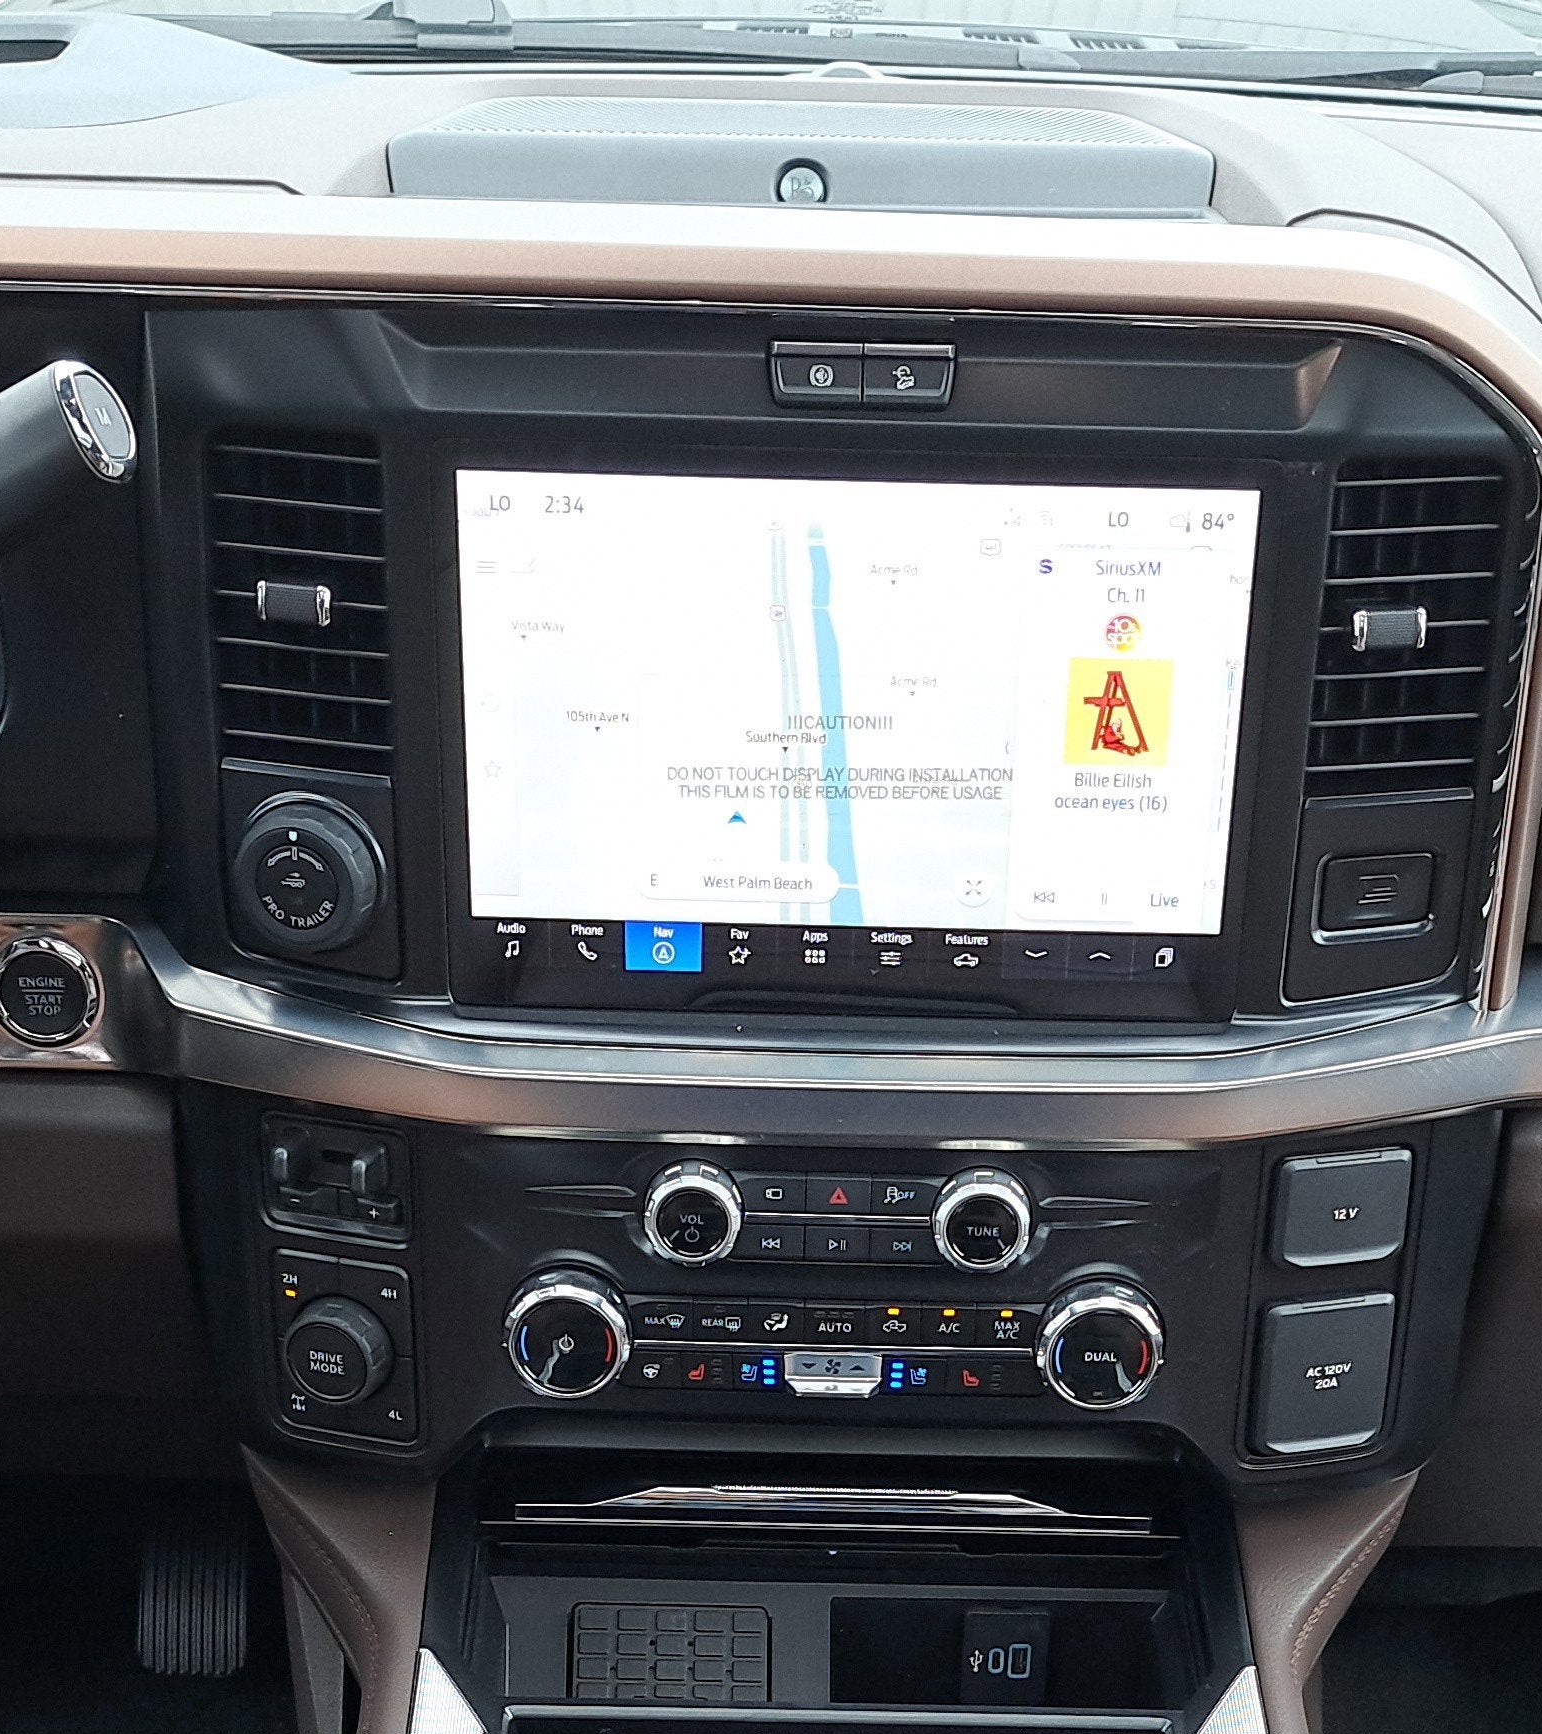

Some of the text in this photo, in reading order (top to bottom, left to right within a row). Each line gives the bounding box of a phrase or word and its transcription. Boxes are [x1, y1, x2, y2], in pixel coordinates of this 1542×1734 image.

[489, 495, 510, 511] LO
[545, 495, 584, 513] 2:34
[1108, 512, 1129, 528] LO
[1201, 513, 1235, 530] 84°
[1096, 560, 1162, 577] SiriusXM
[511, 620, 565, 634] Vista Way
[566, 711, 630, 723] 105th Ave N
[745, 730, 827, 744] Southern Blvd
[667, 767, 1014, 782] DO NOT TOUCH DISPLAY DURING INSTALLATION
[1074, 772, 1152, 788] Billie Eilish
[679, 785, 1003, 800] THIS FILM IS TO BE REMOVED BEFORE USAGE
[1054, 795, 1168, 812] ocean eyes (16)
[703, 876, 812, 890] West Palm Beach
[1150, 893, 1179, 908] Live
[262, 895, 335, 930] PRO TRAILER
[496, 923, 526, 934] Audio
[571, 924, 604, 936] Phone
[653, 927, 673, 938] Nav
[730, 928, 749, 940] Fav
[803, 930, 828, 943] Apps
[870, 931, 913, 945] Settings
[945, 933, 989, 946] Features
[18, 976, 65, 988] ENGINE
[24, 994, 63, 1006] START
[27, 1005, 61, 1016] STOP
[897, 1190, 916, 1201] OFF
[679, 1214, 704, 1225] VOL
[1333, 1207, 1359, 1220] 12 V
[967, 1226, 1000, 1238] TUNE
[281, 1273, 298, 1285] 2H
[380, 1287, 397, 1299] 4H
[644, 1317, 665, 1326] MAX
[701, 1317, 724, 1327] REAR
[818, 1321, 852, 1332] AUTO
[938, 1322, 960, 1333] A/C
[994, 1321, 1020, 1331] MAX
[996, 1330, 1018, 1340] A/C
[309, 1350, 344, 1364] DRIVE
[1084, 1352, 1117, 1363] DUAL
[310, 1361, 345, 1375] MODE
[1306, 1362, 1351, 1378] AC 120V
[1314, 1377, 1338, 1389] 20A
[388, 1410, 403, 1421] 4L
